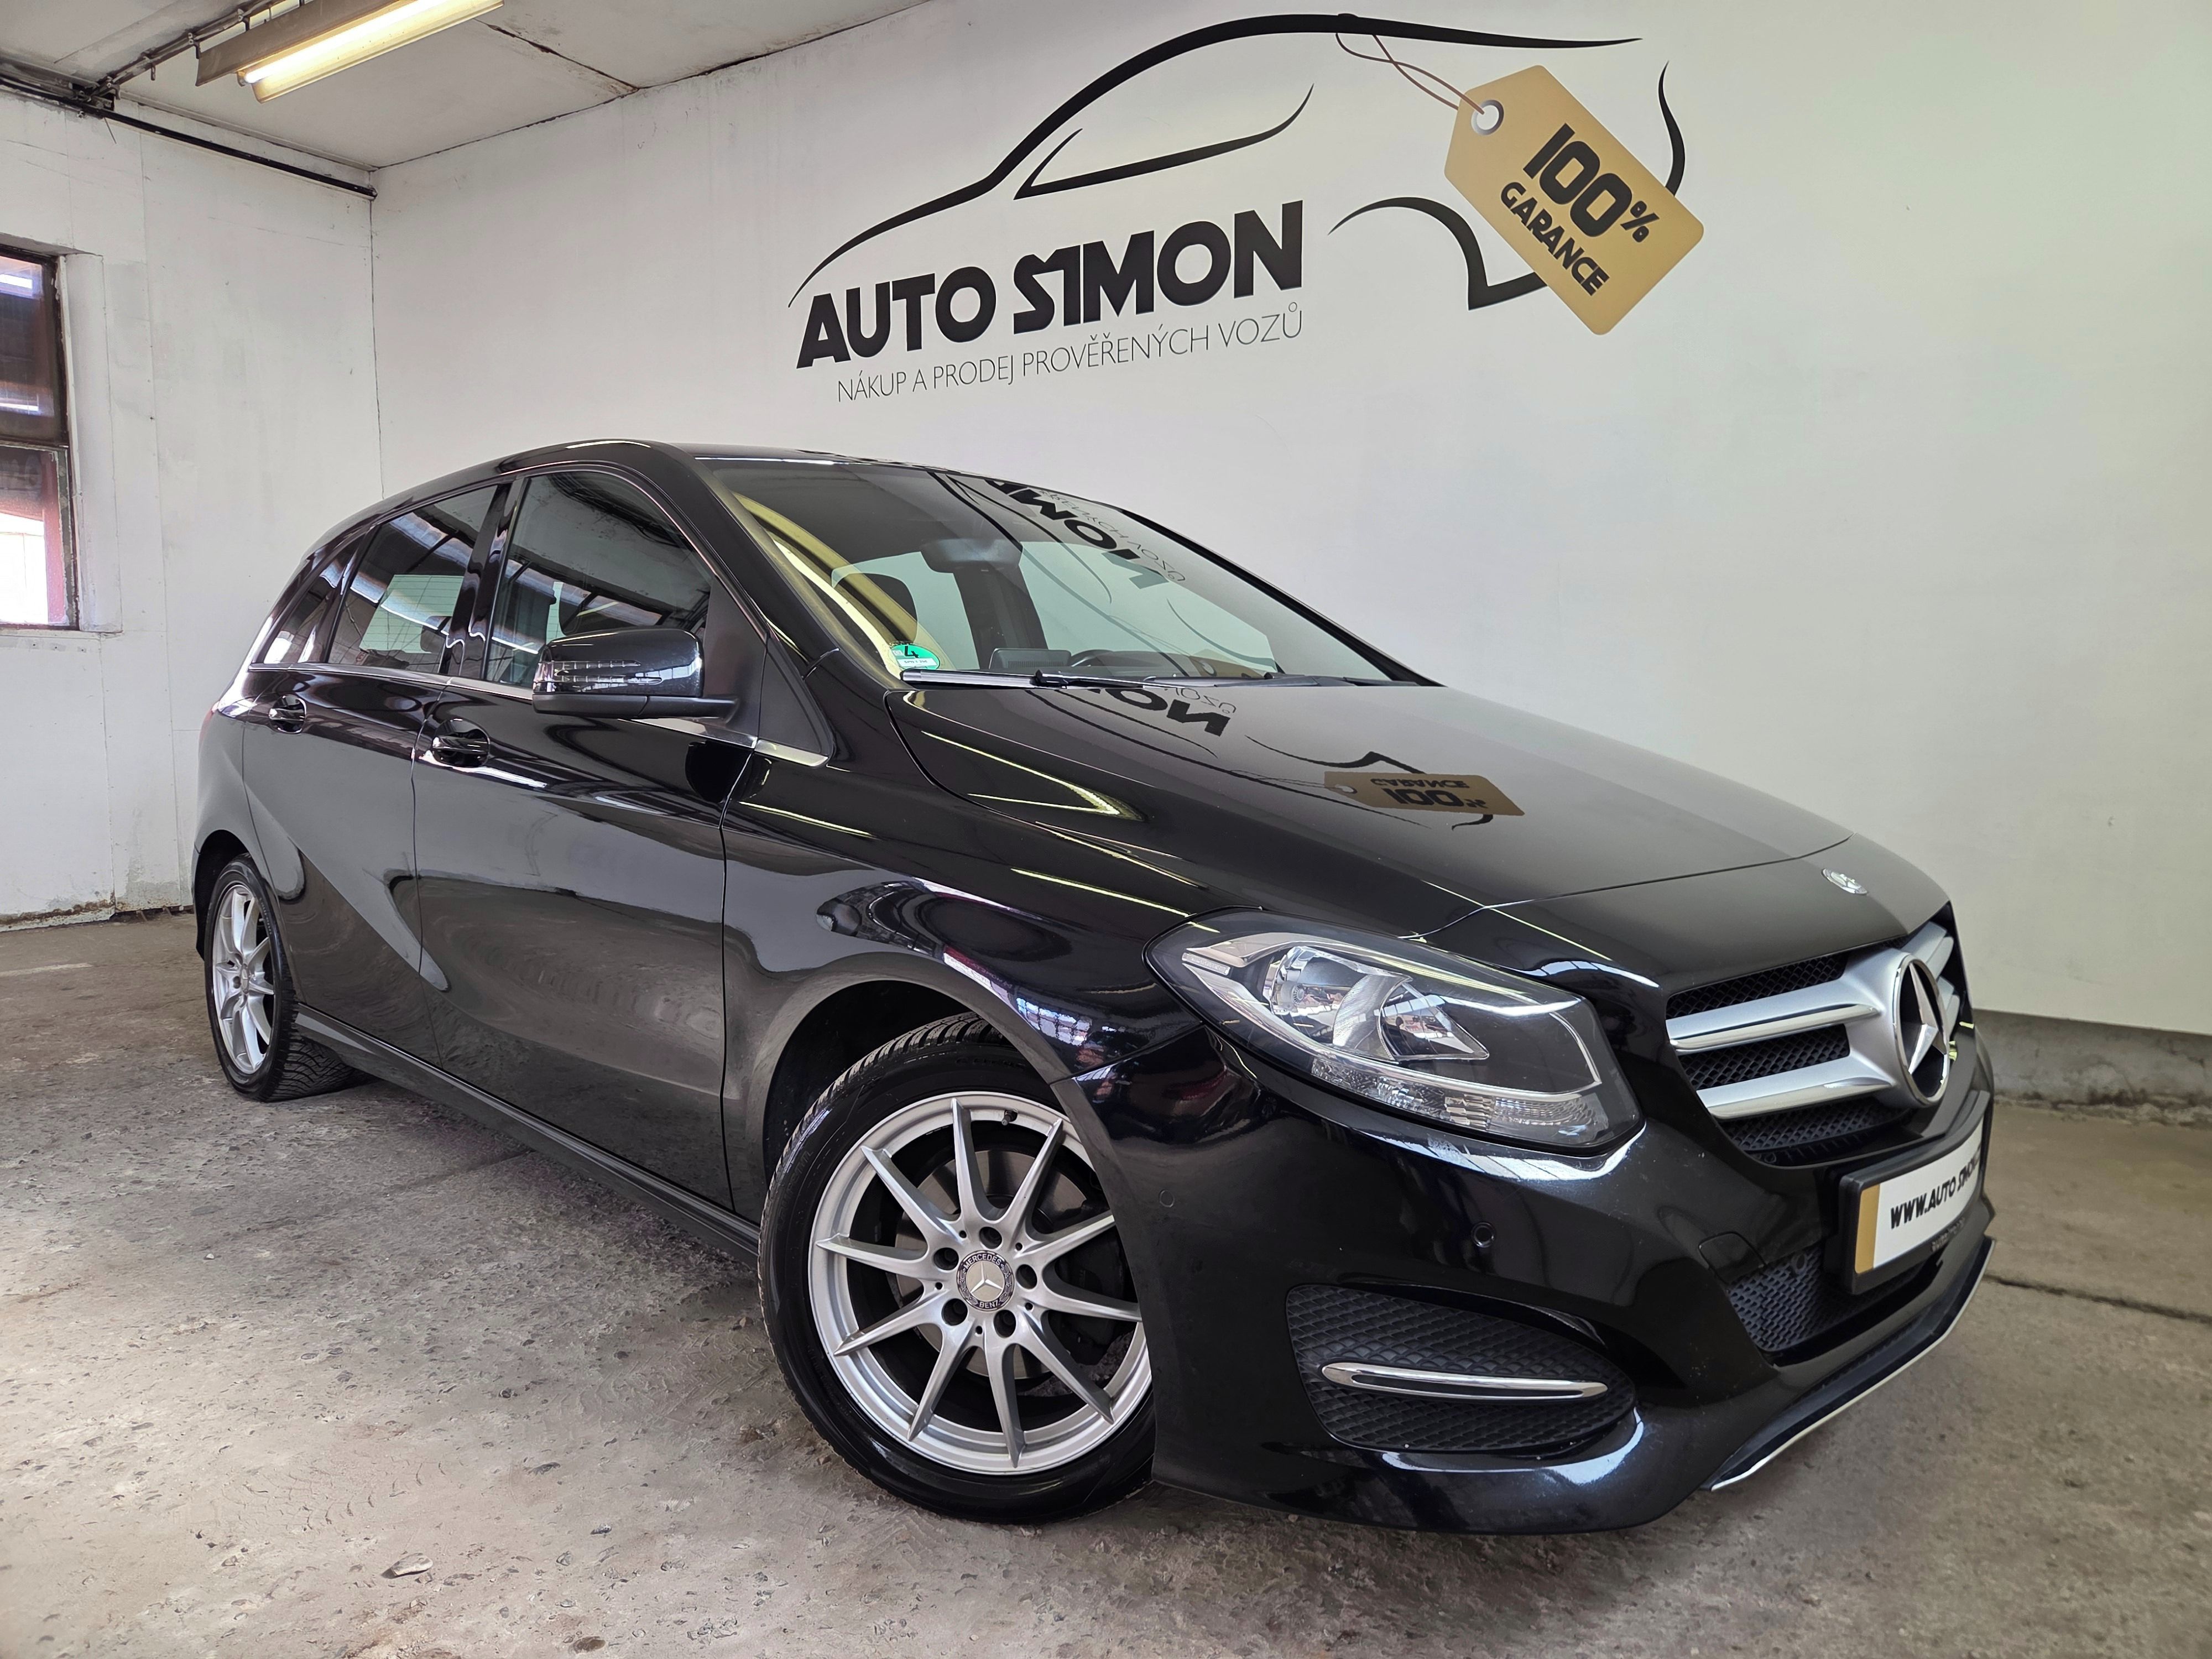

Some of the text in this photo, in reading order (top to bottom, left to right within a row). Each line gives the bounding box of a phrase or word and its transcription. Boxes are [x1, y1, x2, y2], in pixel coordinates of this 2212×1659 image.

[1523, 123, 1660, 243] 100%
[1501, 182, 1610, 296] GARANCE
[796, 267, 997, 369] AUTO
[838, 301, 1302, 403] NÁKUP A PRODEJ PROVĚŘENÝCH VOZŮ
[1890, 1176, 1957, 1230] WWW.AUTO
[963, 1254, 1001, 1270] MERCEDES
[979, 1300, 999, 1308] BENZ
